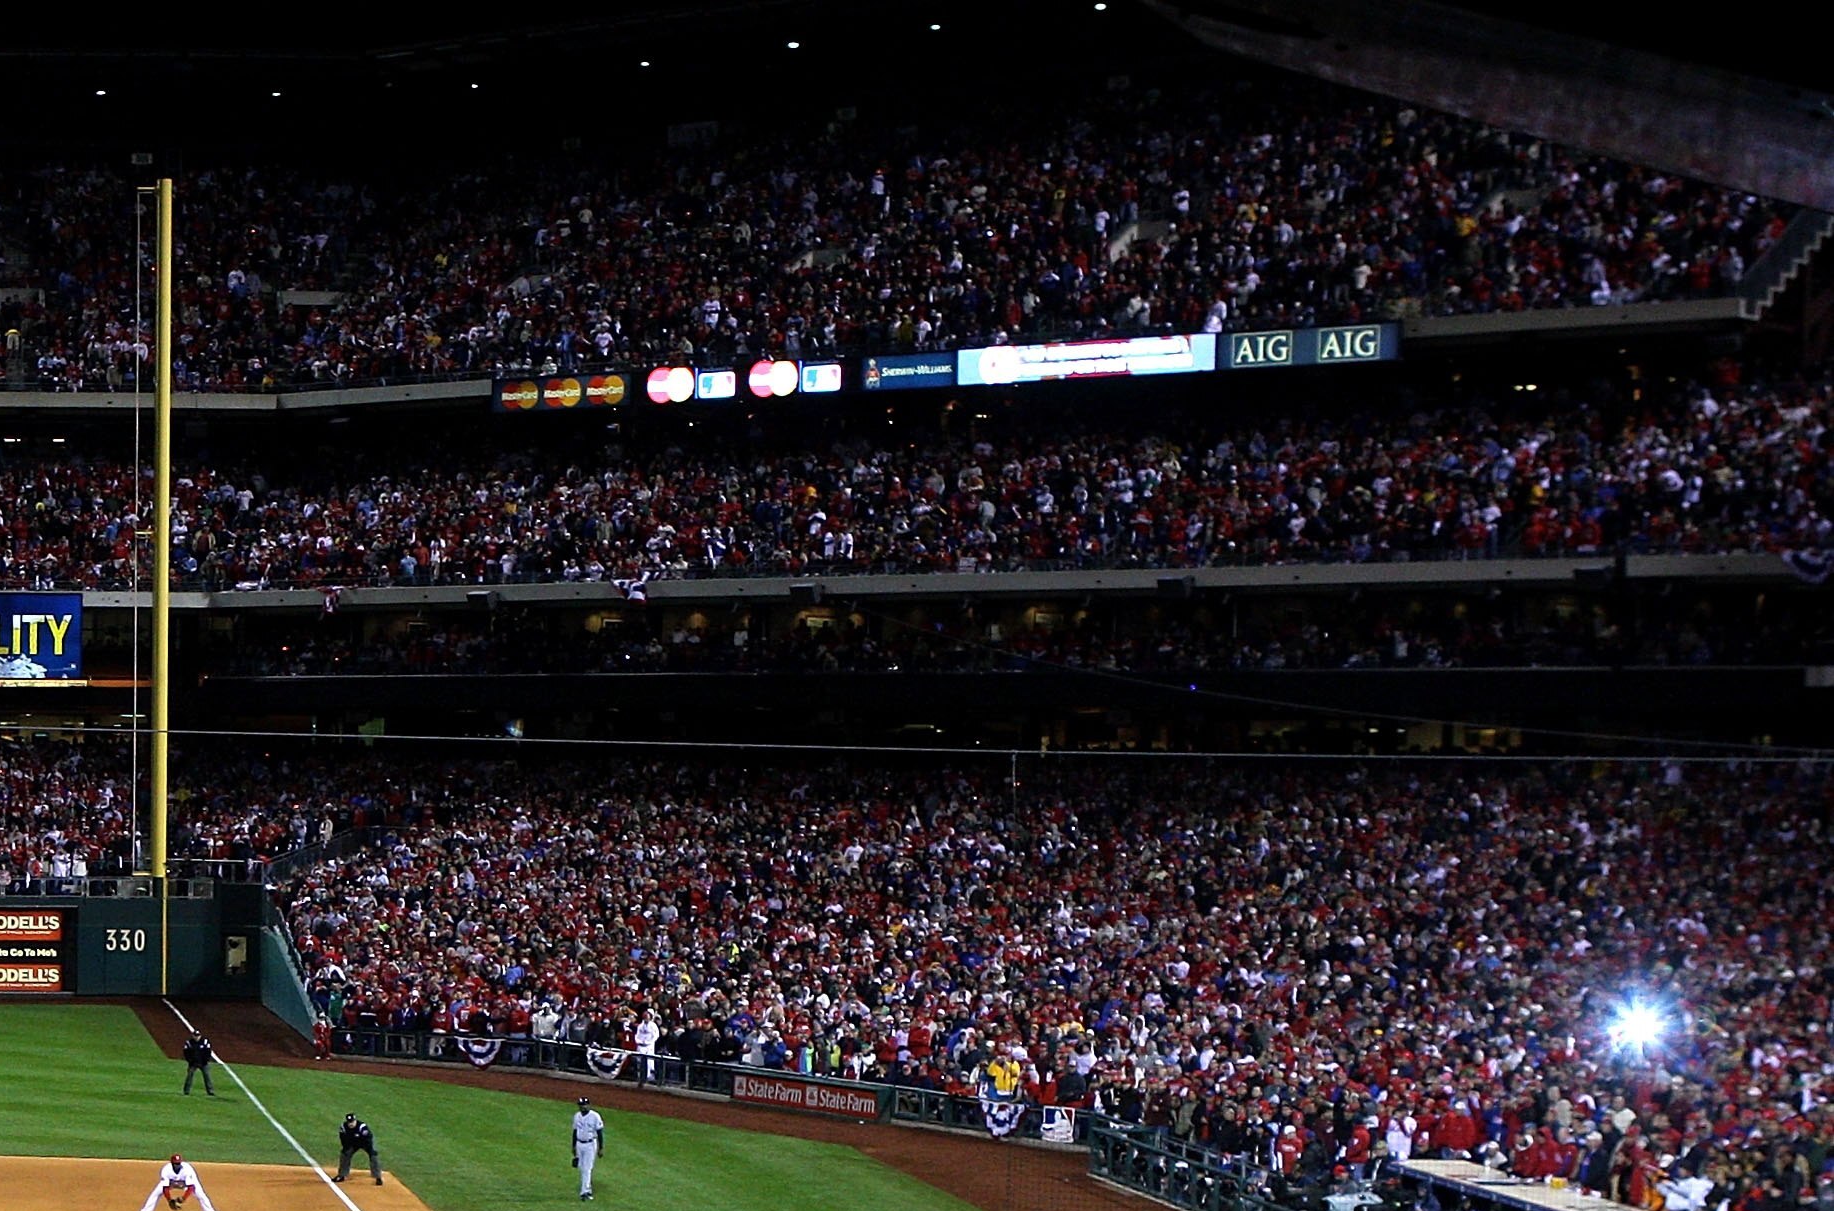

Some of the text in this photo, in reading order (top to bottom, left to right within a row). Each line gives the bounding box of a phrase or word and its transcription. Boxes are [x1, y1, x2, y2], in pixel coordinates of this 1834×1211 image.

[1235, 336, 1288, 363] AIG
[1320, 330, 1376, 358] AIG
[105, 929, 146, 951] 330
[747, 1078, 802, 1104] State Farm
[819, 1089, 876, 1114] State Farm
